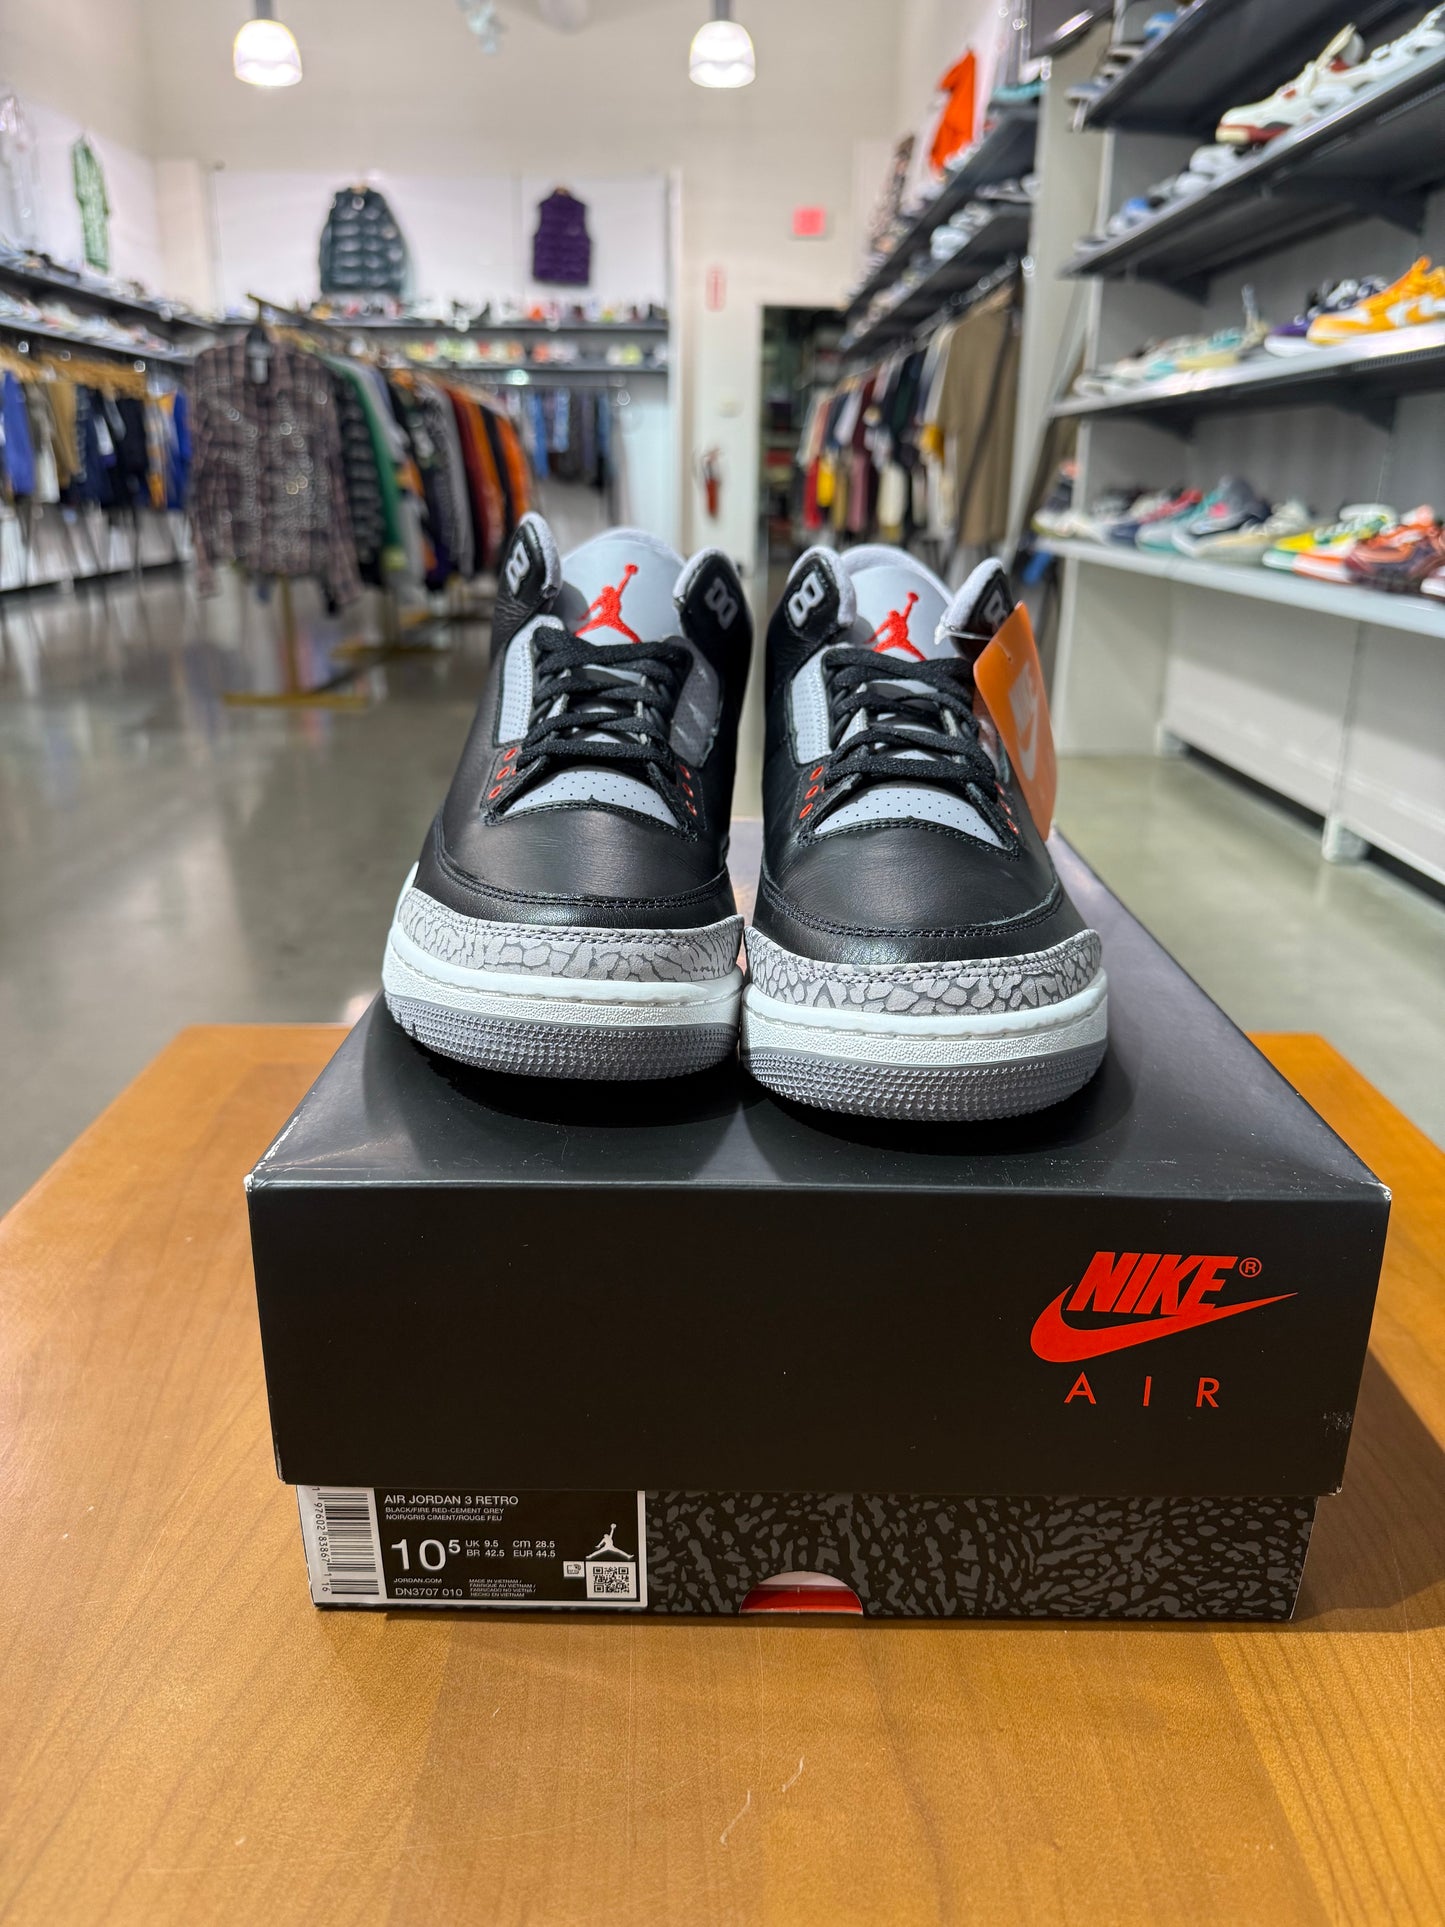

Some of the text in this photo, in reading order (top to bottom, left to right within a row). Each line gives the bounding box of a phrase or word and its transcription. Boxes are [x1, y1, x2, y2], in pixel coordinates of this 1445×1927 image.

[1064, 1371, 1220, 1408] AIR
[384, 1494, 519, 1505] AIR JORDAN 3 RETRO
[385, 1506, 430, 1514] BLACK/FIRE
[483, 1507, 504, 1515] GREY
[386, 1513, 426, 1521] NOIR/GRIS
[487, 1514, 503, 1522] FEU
[465, 1539, 480, 1548] UK
[484, 1540, 499, 1548] 9.5
[535, 1540, 556, 1548] 28.5
[318, 1536, 330, 1563] 83867
[466, 1549, 556, 1558] BR 42.5 EUR 44.5
[395, 1587, 463, 1597] DN3707 010
